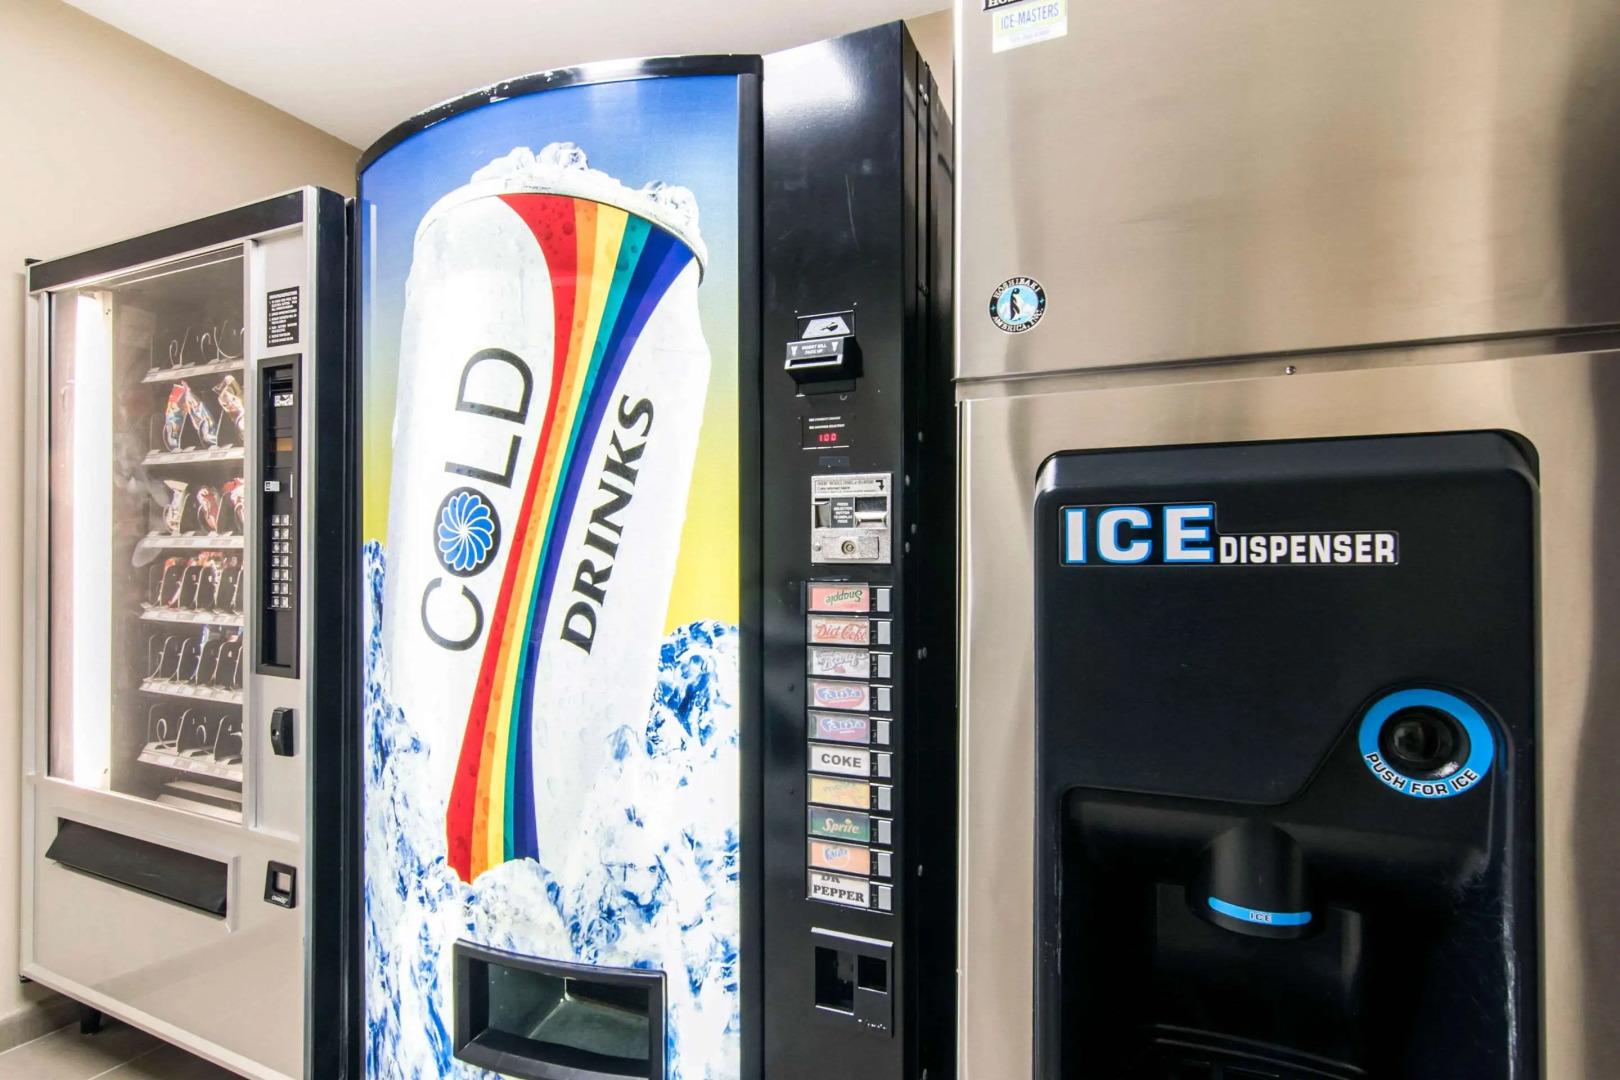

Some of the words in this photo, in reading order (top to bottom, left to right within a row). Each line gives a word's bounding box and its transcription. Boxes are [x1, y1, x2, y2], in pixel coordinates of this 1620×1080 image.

[1001, 3, 1059, 30] ICE-MASTERS
[993, 278, 1041, 299] HOSHIZAKI
[1029, 308, 1044, 326] INC.
[818, 432, 838, 442] 100
[560, 394, 655, 656] DRINKS
[1064, 504, 1215, 564] ICE
[1219, 533, 1396, 564] DISPENSER
[825, 590, 863, 605] Snapple
[815, 623, 841, 639] Diet
[841, 623, 868, 643] Coke
[817, 686, 862, 701] Fanta
[821, 717, 867, 733] Fanta
[821, 753, 862, 768] COKE
[1365, 752, 1407, 790] PUSH
[1410, 782, 1449, 796] FOR
[1451, 769, 1479, 791] ICE
[822, 817, 860, 834] Sprite
[813, 884, 865, 903] PEPPER
[1250, 912, 1272, 922] ICE
